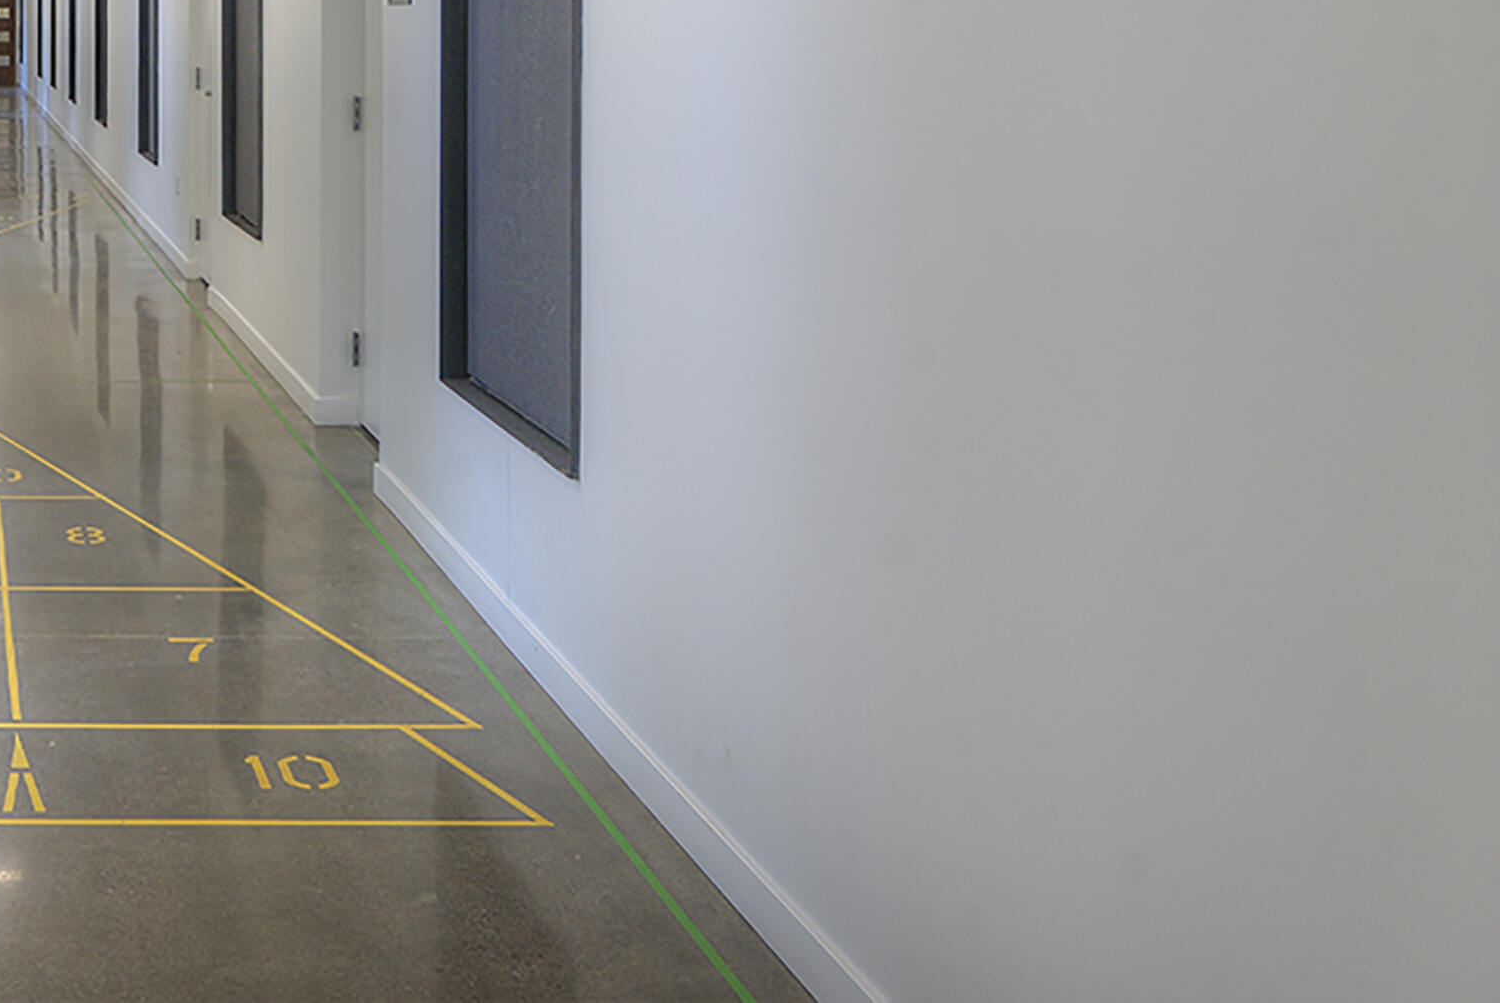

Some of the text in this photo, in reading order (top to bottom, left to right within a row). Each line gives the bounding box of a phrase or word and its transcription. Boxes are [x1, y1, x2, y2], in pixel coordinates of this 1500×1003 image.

[65, 526, 106, 545] 8
[168, 637, 214, 662] 7
[244, 755, 340, 789] 10
